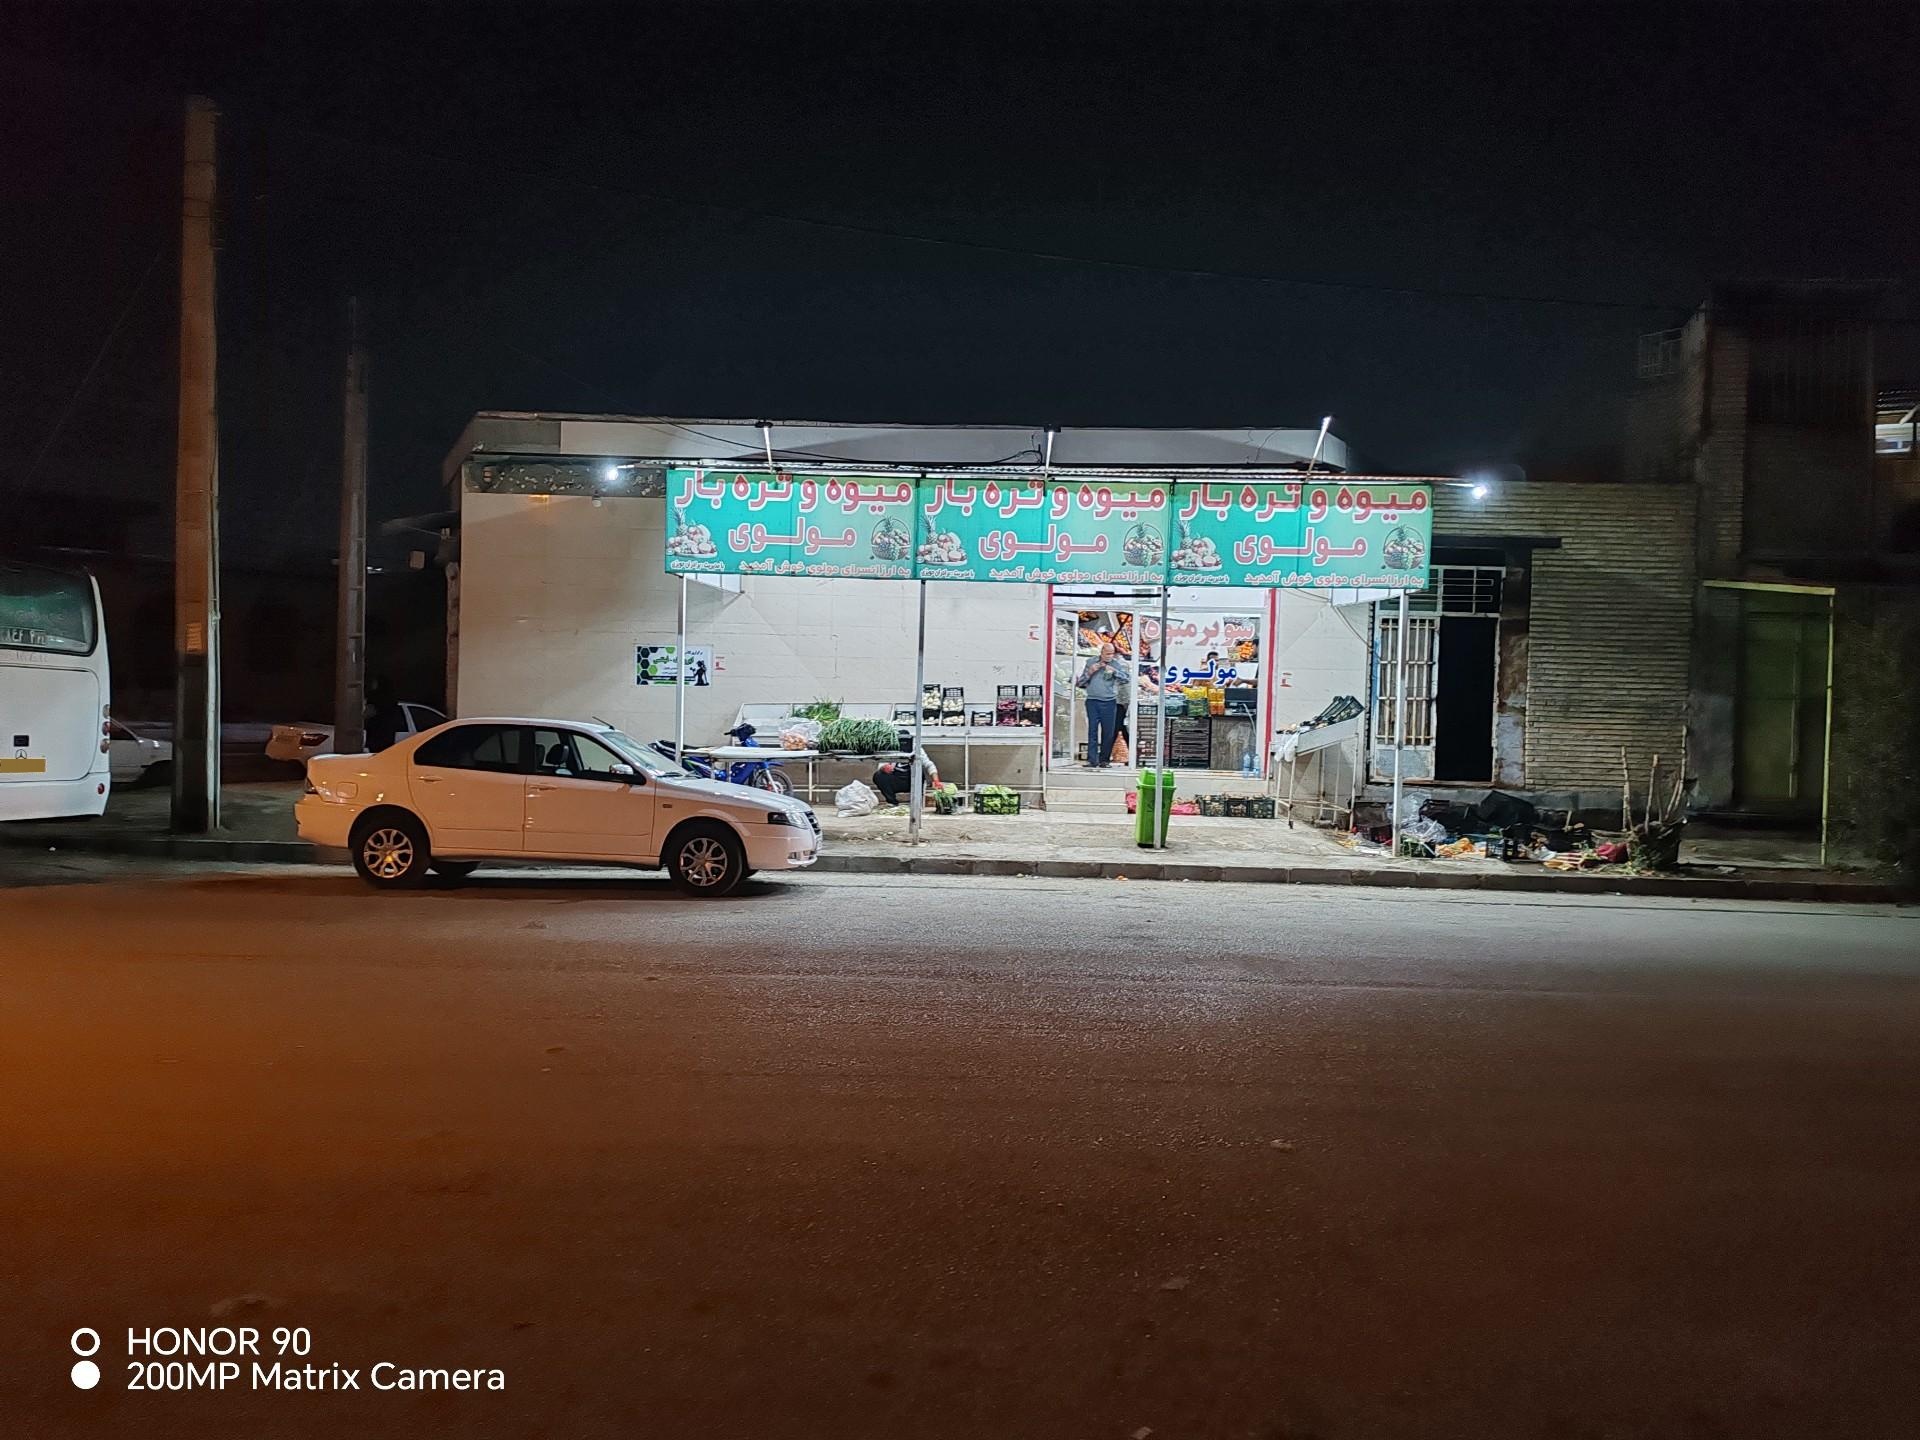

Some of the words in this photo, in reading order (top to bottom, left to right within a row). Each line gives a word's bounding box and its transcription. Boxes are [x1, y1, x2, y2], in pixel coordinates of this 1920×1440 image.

[675, 469, 725, 508] بار
[732, 471, 792, 509] تره
[800, 479, 818, 511] و
[826, 478, 912, 512] میوه
[926, 478, 976, 516] بار
[983, 480, 1044, 518] تره
[1051, 486, 1070, 519] و
[1078, 484, 1166, 520] میوه
[1180, 483, 1232, 521] بار
[1239, 483, 1301, 522] تره
[1335, 486, 1428, 522] میوه
[1309, 489, 1328, 522] و
[729, 517, 856, 554] مولوی
[979, 524, 1109, 562] مولوی
[1234, 527, 1368, 565] مولوی
[739, 558, 774, 573] آمدید
[776, 559, 805, 574] خوش
[807, 562, 839, 575] مولوی
[989, 566, 1025, 581] آمدید
[1025, 567, 1056, 582] خوش
[1057, 569, 1090, 582] مولوی
[1244, 570, 1280, 584] آمدید
[1281, 572, 1312, 586] خوش
[1314, 574, 1348, 587] مولوی
[1164, 660, 1237, 684] مولوی
